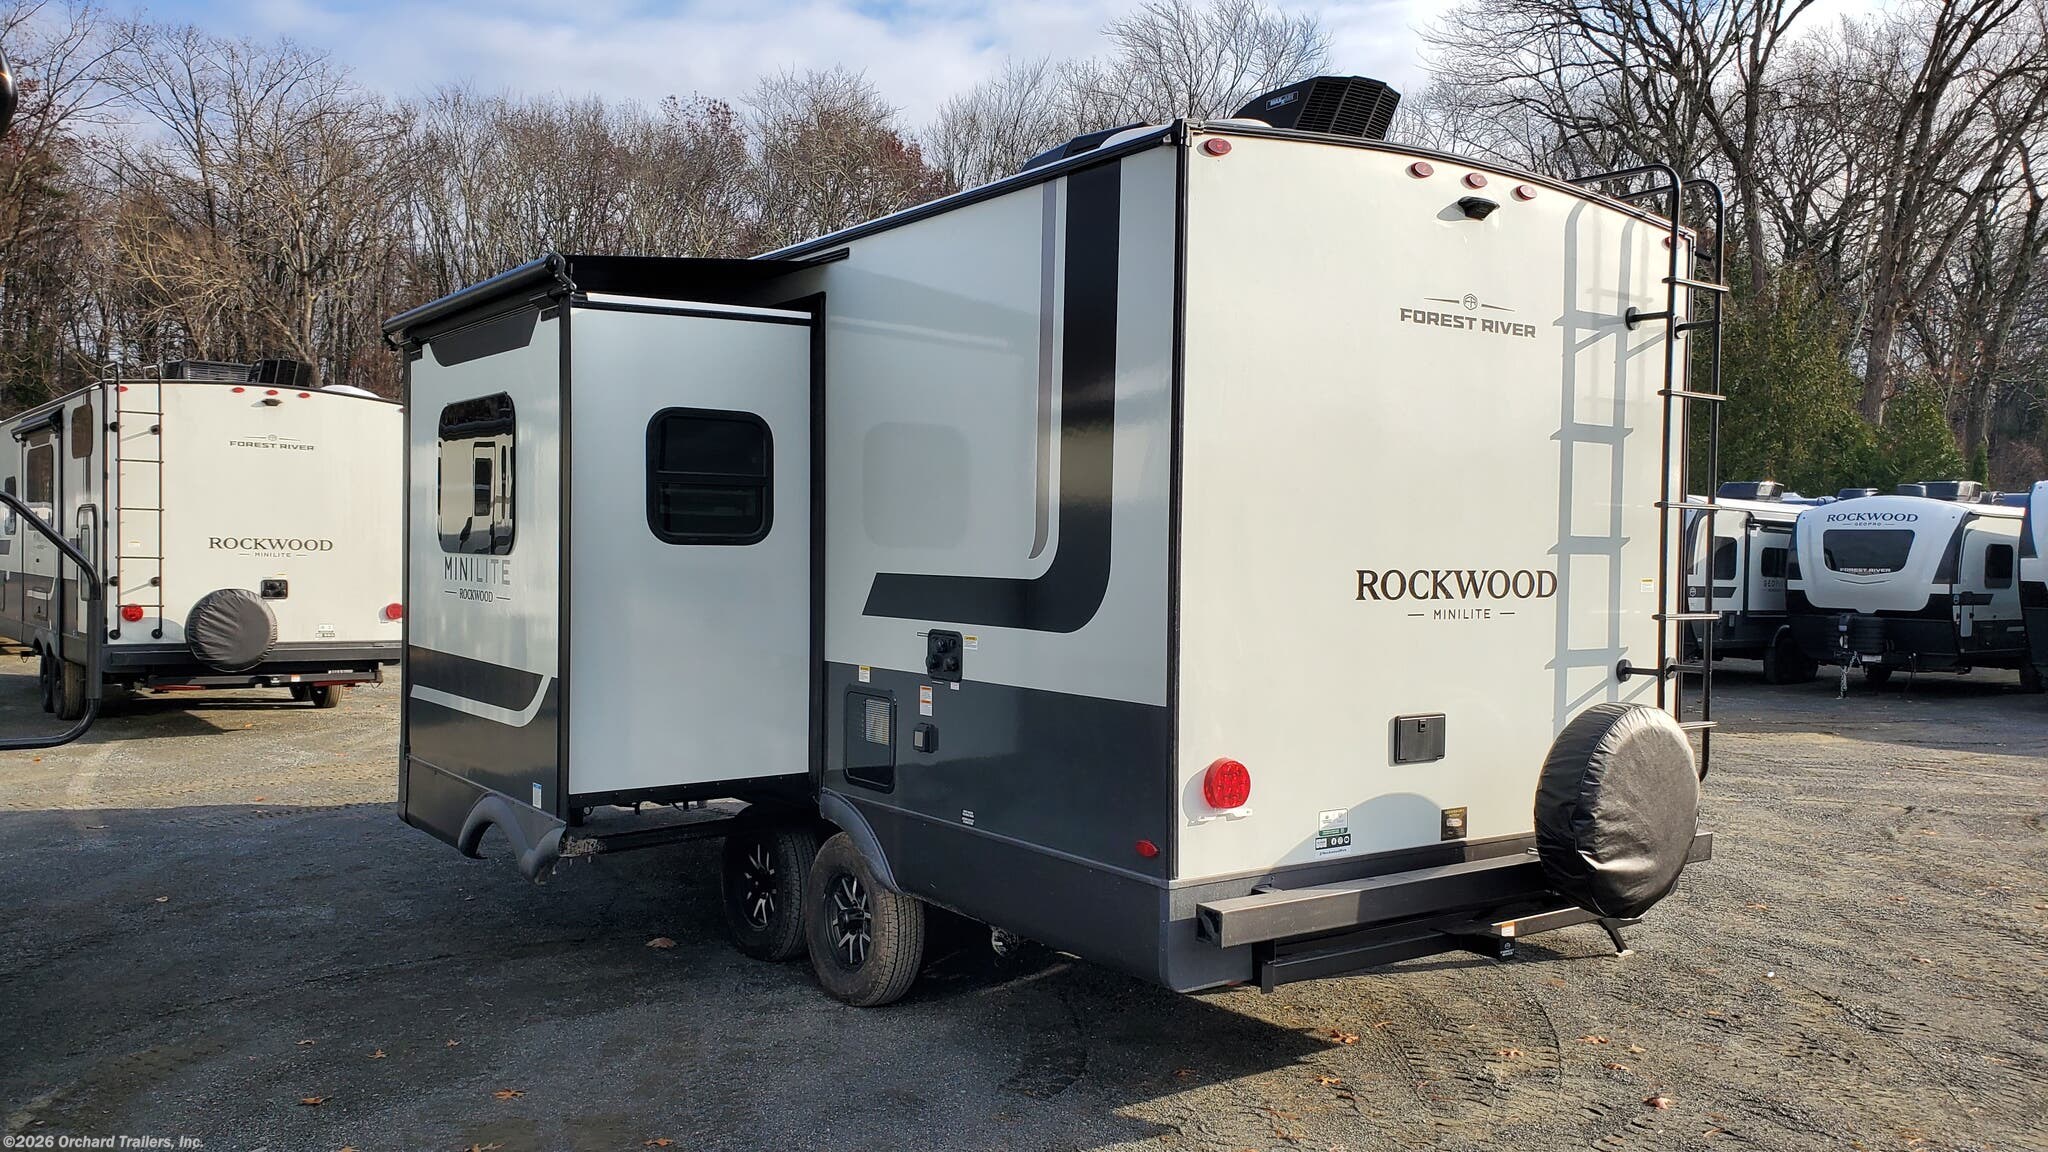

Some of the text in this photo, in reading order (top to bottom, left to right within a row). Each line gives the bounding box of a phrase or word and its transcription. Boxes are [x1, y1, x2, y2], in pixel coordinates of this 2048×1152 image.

[1400, 307, 1536, 338] FOREST RIVER
[229, 440, 315, 451] FOREST RIVER
[1826, 512, 1919, 522] ROCKWOOD
[209, 537, 334, 552] ROCKWOOD
[444, 556, 511, 585] MINILITE
[1355, 569, 1558, 601] ROCKWOOD
[459, 588, 494, 602] ROCKWOOD
[1433, 609, 1491, 619] MINILITE
